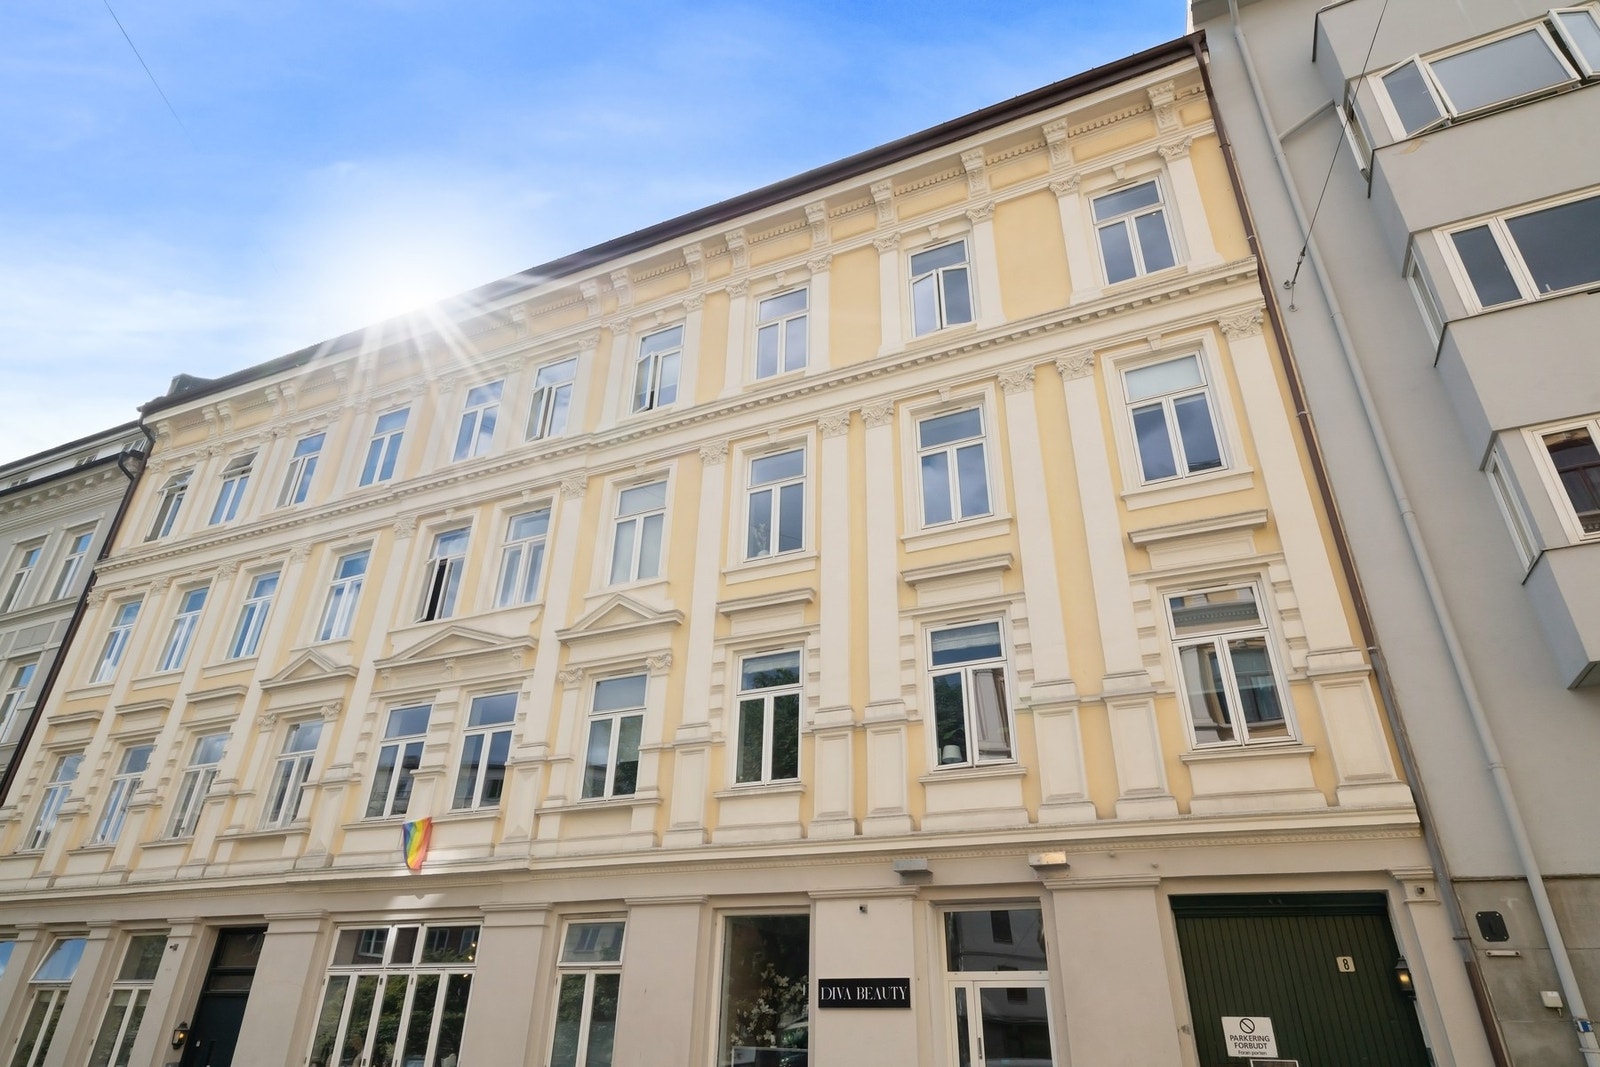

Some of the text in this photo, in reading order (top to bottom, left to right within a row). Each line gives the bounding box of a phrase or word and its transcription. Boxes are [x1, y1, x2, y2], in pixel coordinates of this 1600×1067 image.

[1342, 958, 1350, 970] 8
[821, 986, 907, 1000] DIVA BEAUTY
